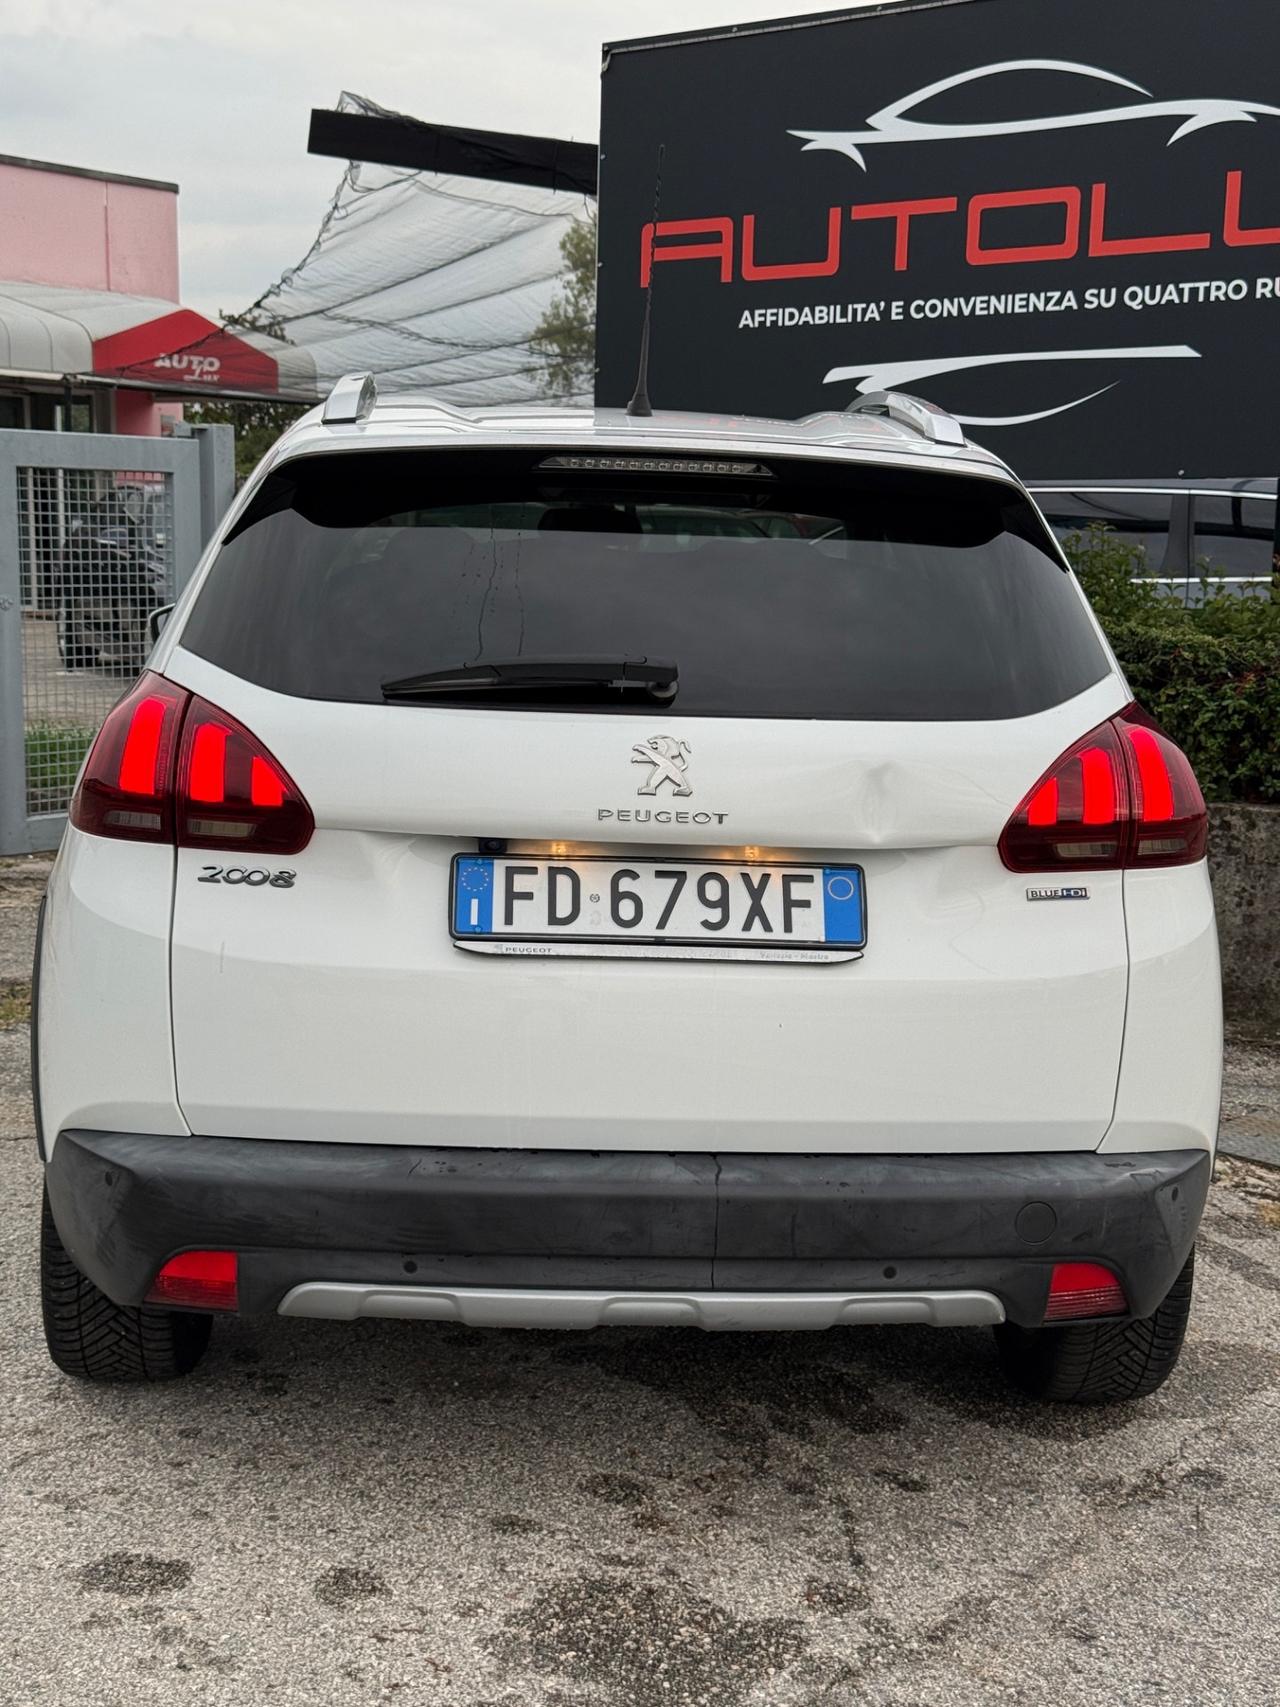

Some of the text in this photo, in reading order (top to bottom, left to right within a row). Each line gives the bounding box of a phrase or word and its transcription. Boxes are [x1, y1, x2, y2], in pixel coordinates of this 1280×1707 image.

[890, 301, 904, 321] E
[909, 290, 1078, 320] CONVENIENZA
[1084, 287, 1117, 310] SU
[1123, 279, 1248, 311] QUATTRO
[1255, 277, 1280, 299] R
[154, 353, 221, 372] AUTO
[598, 808, 729, 825] PEUGEOT
[197, 864, 297, 889] 2008
[470, 898, 479, 926] I
[504, 865, 815, 934] FD 679XF
[505, 946, 553, 954] PEUGEOT
